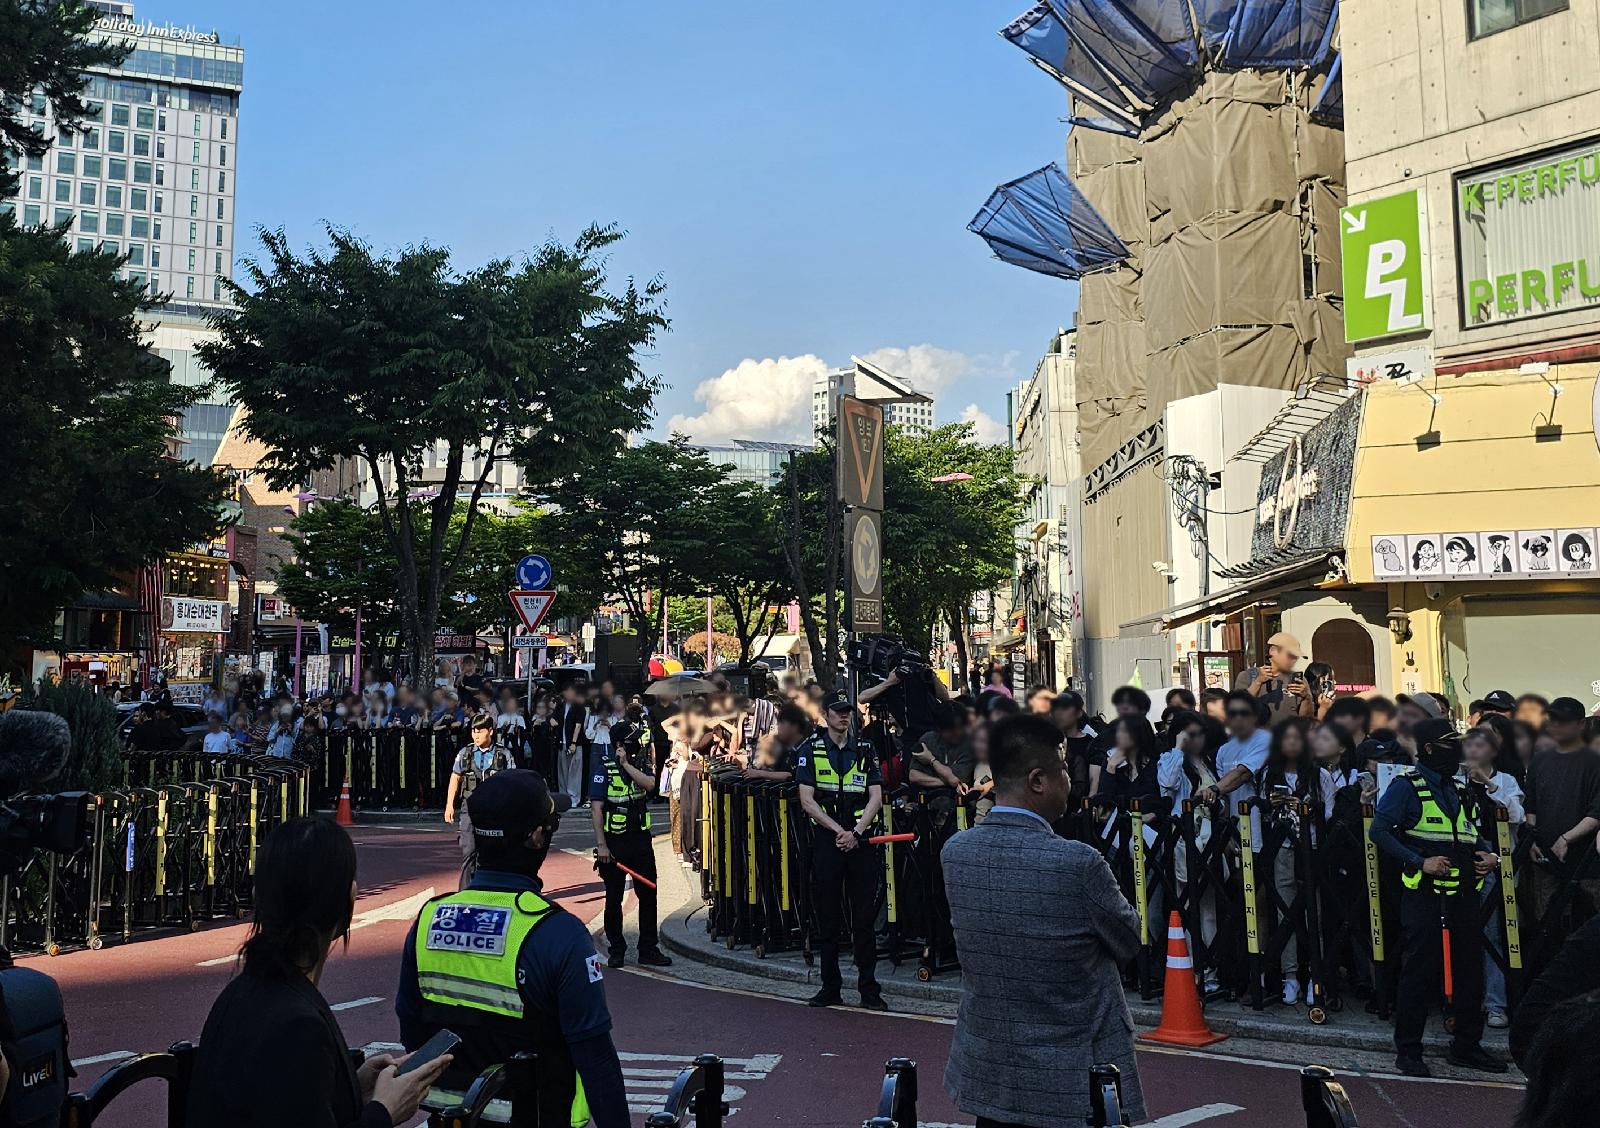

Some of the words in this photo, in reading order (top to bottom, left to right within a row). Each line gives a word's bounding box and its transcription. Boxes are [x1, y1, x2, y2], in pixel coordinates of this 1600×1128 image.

[91, 16, 145, 36] Holiday
[147, 19, 170, 37] Inn
[170, 26, 217, 43] Express
[1462, 152, 1600, 212] K-PERFU
[1468, 258, 1600, 317] PERFU
[177, 602, 218, 620] 홍대순대천국
[1133, 834, 1142, 886] POLICE
[1367, 843, 1378, 898] POLICE
[1241, 838, 1257, 940] 질서유지선
[1501, 847, 1519, 954] 질서유지선
[433, 933, 495, 950] POLICE
[1372, 908, 1381, 946] LINE
